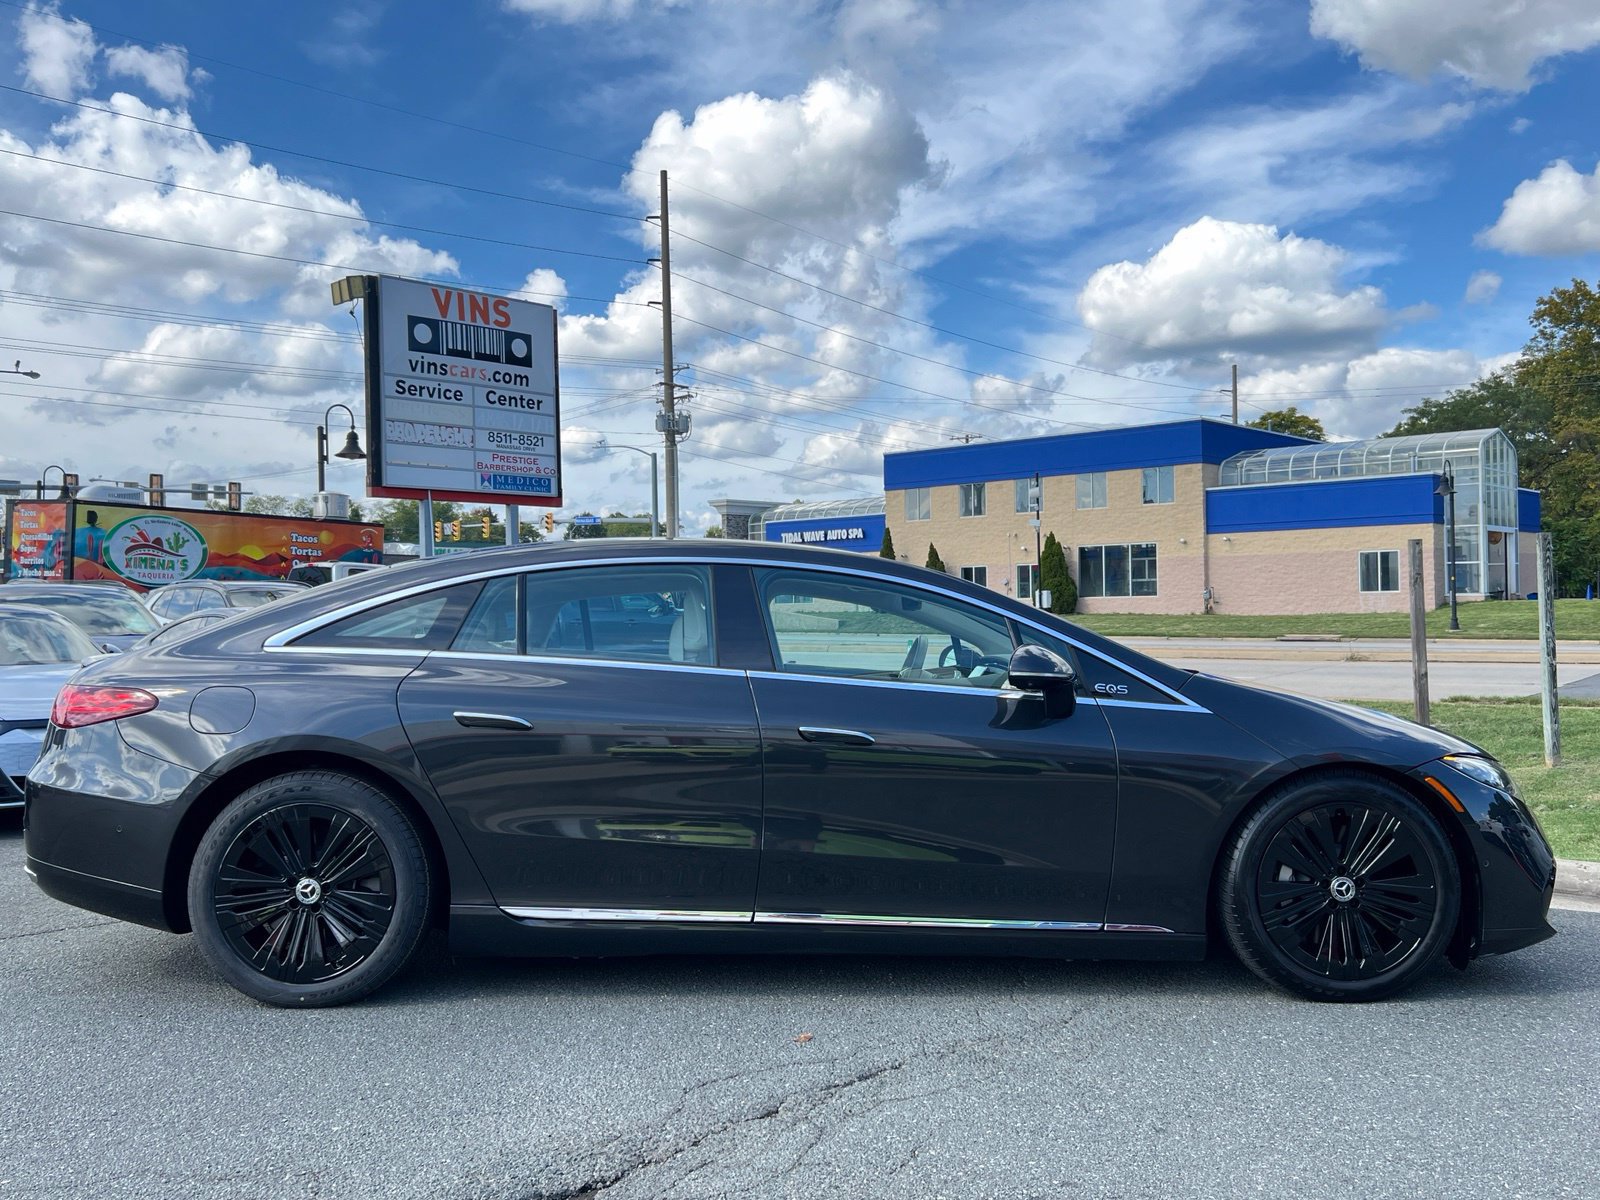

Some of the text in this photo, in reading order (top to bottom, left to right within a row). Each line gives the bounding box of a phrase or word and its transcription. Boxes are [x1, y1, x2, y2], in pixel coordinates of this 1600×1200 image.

[431, 288, 511, 328] VINS
[408, 356, 529, 387] vinscars.com
[395, 379, 543, 411] Service Center
[488, 432, 544, 447] 8511-8521
[492, 454, 539, 465] PRESTIGE
[477, 462, 534, 474] BARBERSHOP
[496, 475, 549, 486] MEDICO
[524, 485, 548, 493] CLINIC
[20, 509, 36, 517] Tacos
[290, 532, 318, 543] Tacos
[781, 528, 864, 543] TIDAL WAVE AUTO SPA
[290, 546, 322, 556] Tortas
[125, 556, 188, 571] XIMENA'S
[138, 572, 174, 580] TAQUERIA
[1094, 683, 1128, 694] EQS
[204, 786, 312, 866] GOODYEAR
